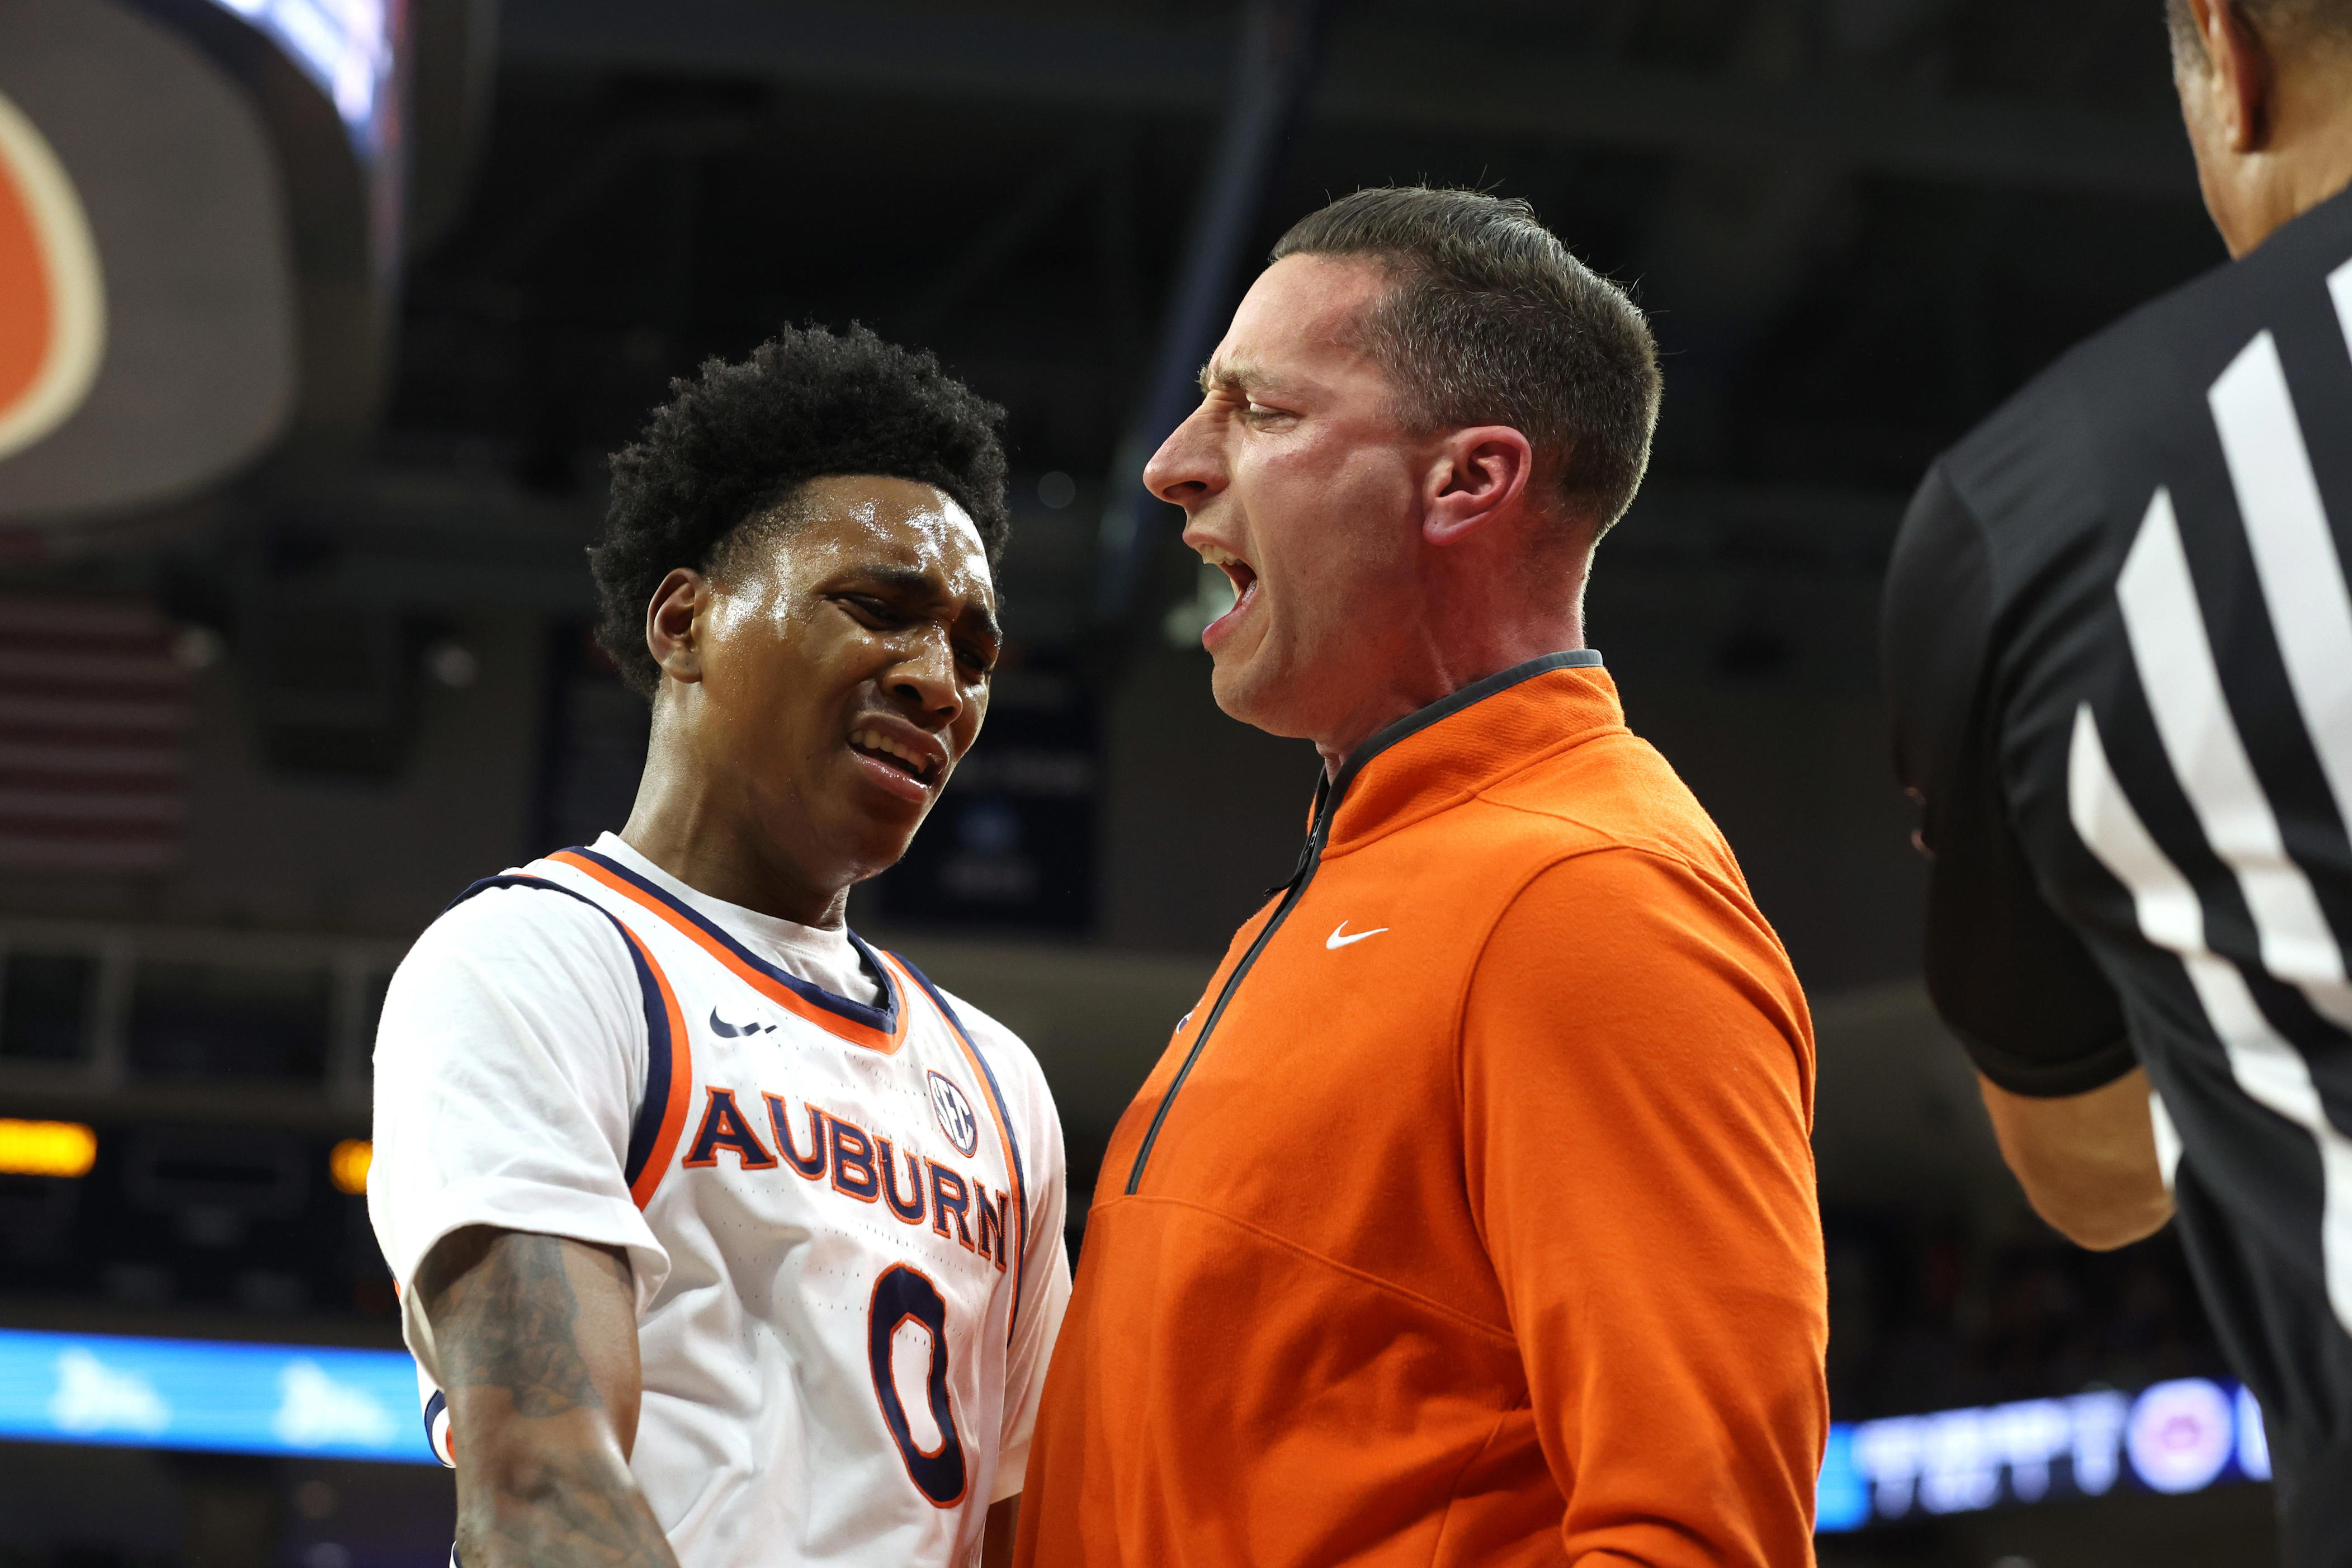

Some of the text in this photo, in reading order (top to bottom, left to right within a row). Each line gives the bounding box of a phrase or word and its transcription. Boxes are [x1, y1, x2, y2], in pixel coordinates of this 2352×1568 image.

[682, 1085, 1009, 1272] AUBURN
[930, 1076, 974, 1150] SEC
[868, 1262, 967, 1509] 0
